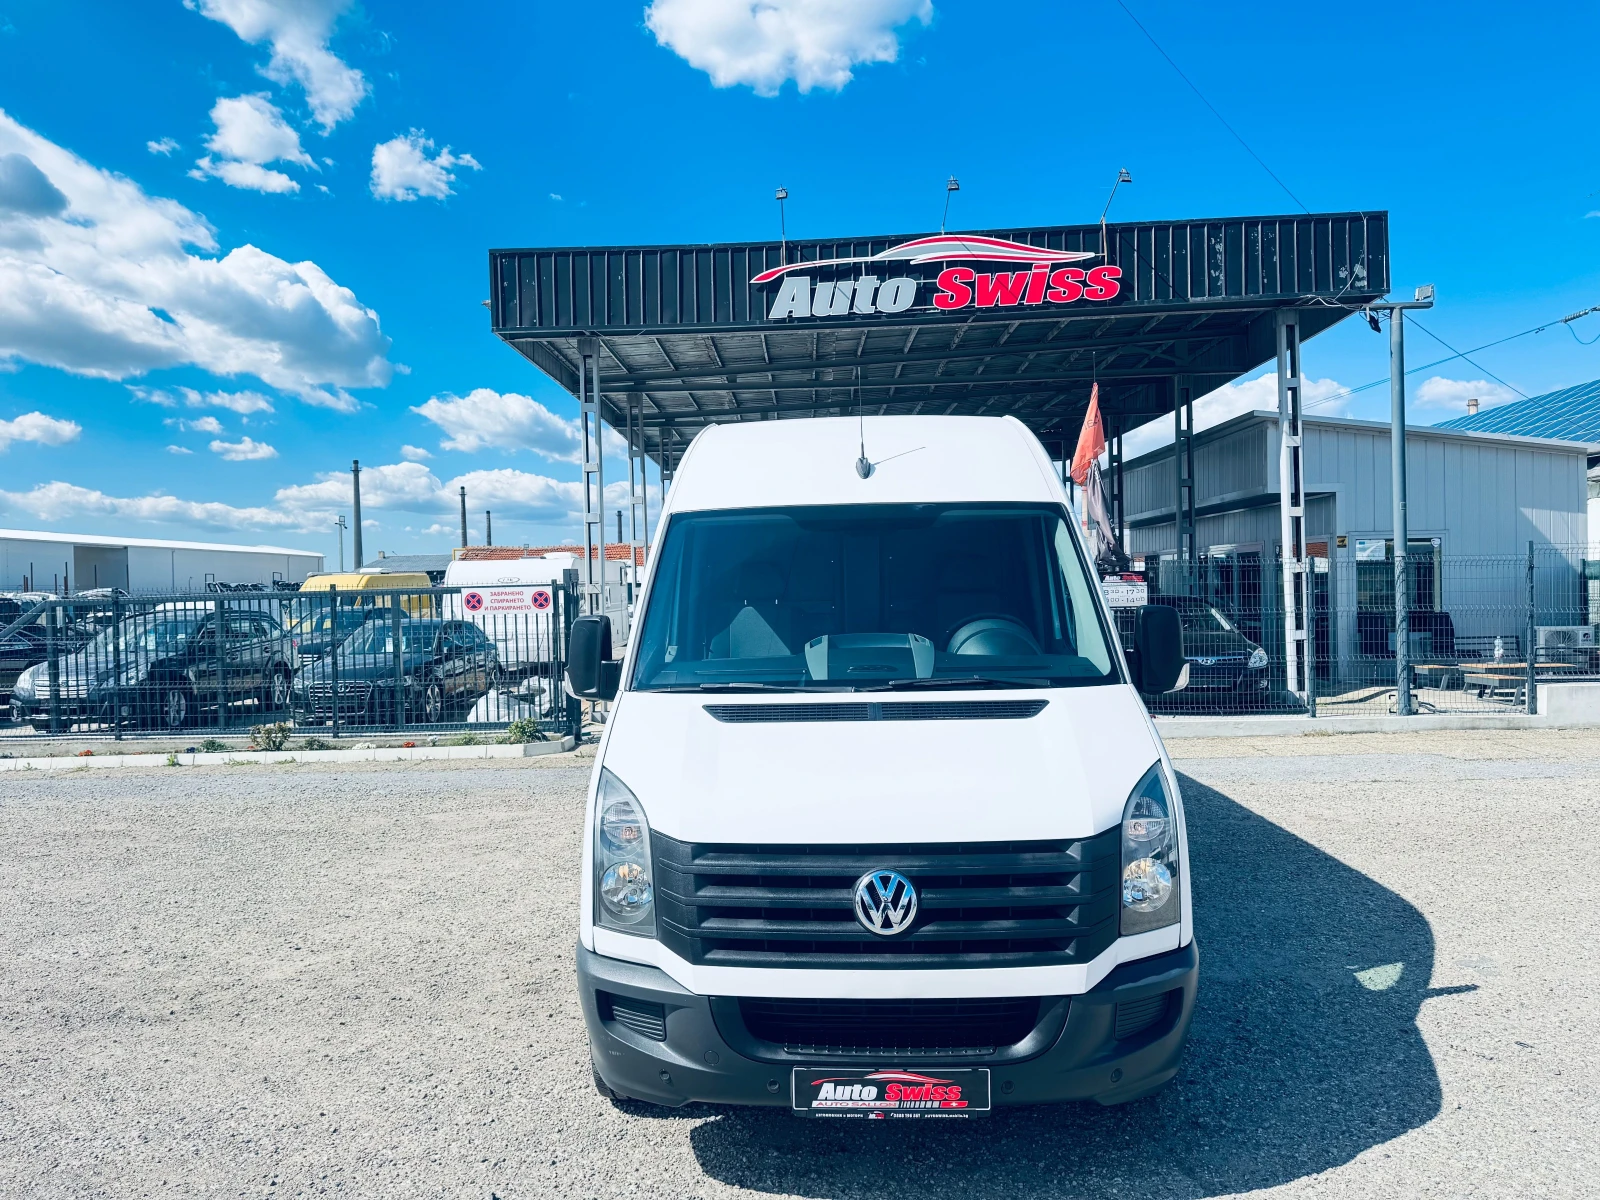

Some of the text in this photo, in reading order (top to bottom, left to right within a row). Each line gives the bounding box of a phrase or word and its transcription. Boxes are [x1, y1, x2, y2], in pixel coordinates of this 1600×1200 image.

[768, 262, 1123, 319] Auto Swiss
[856, 869, 917, 935] VW
[817, 1082, 962, 1101] Auto Swiss
